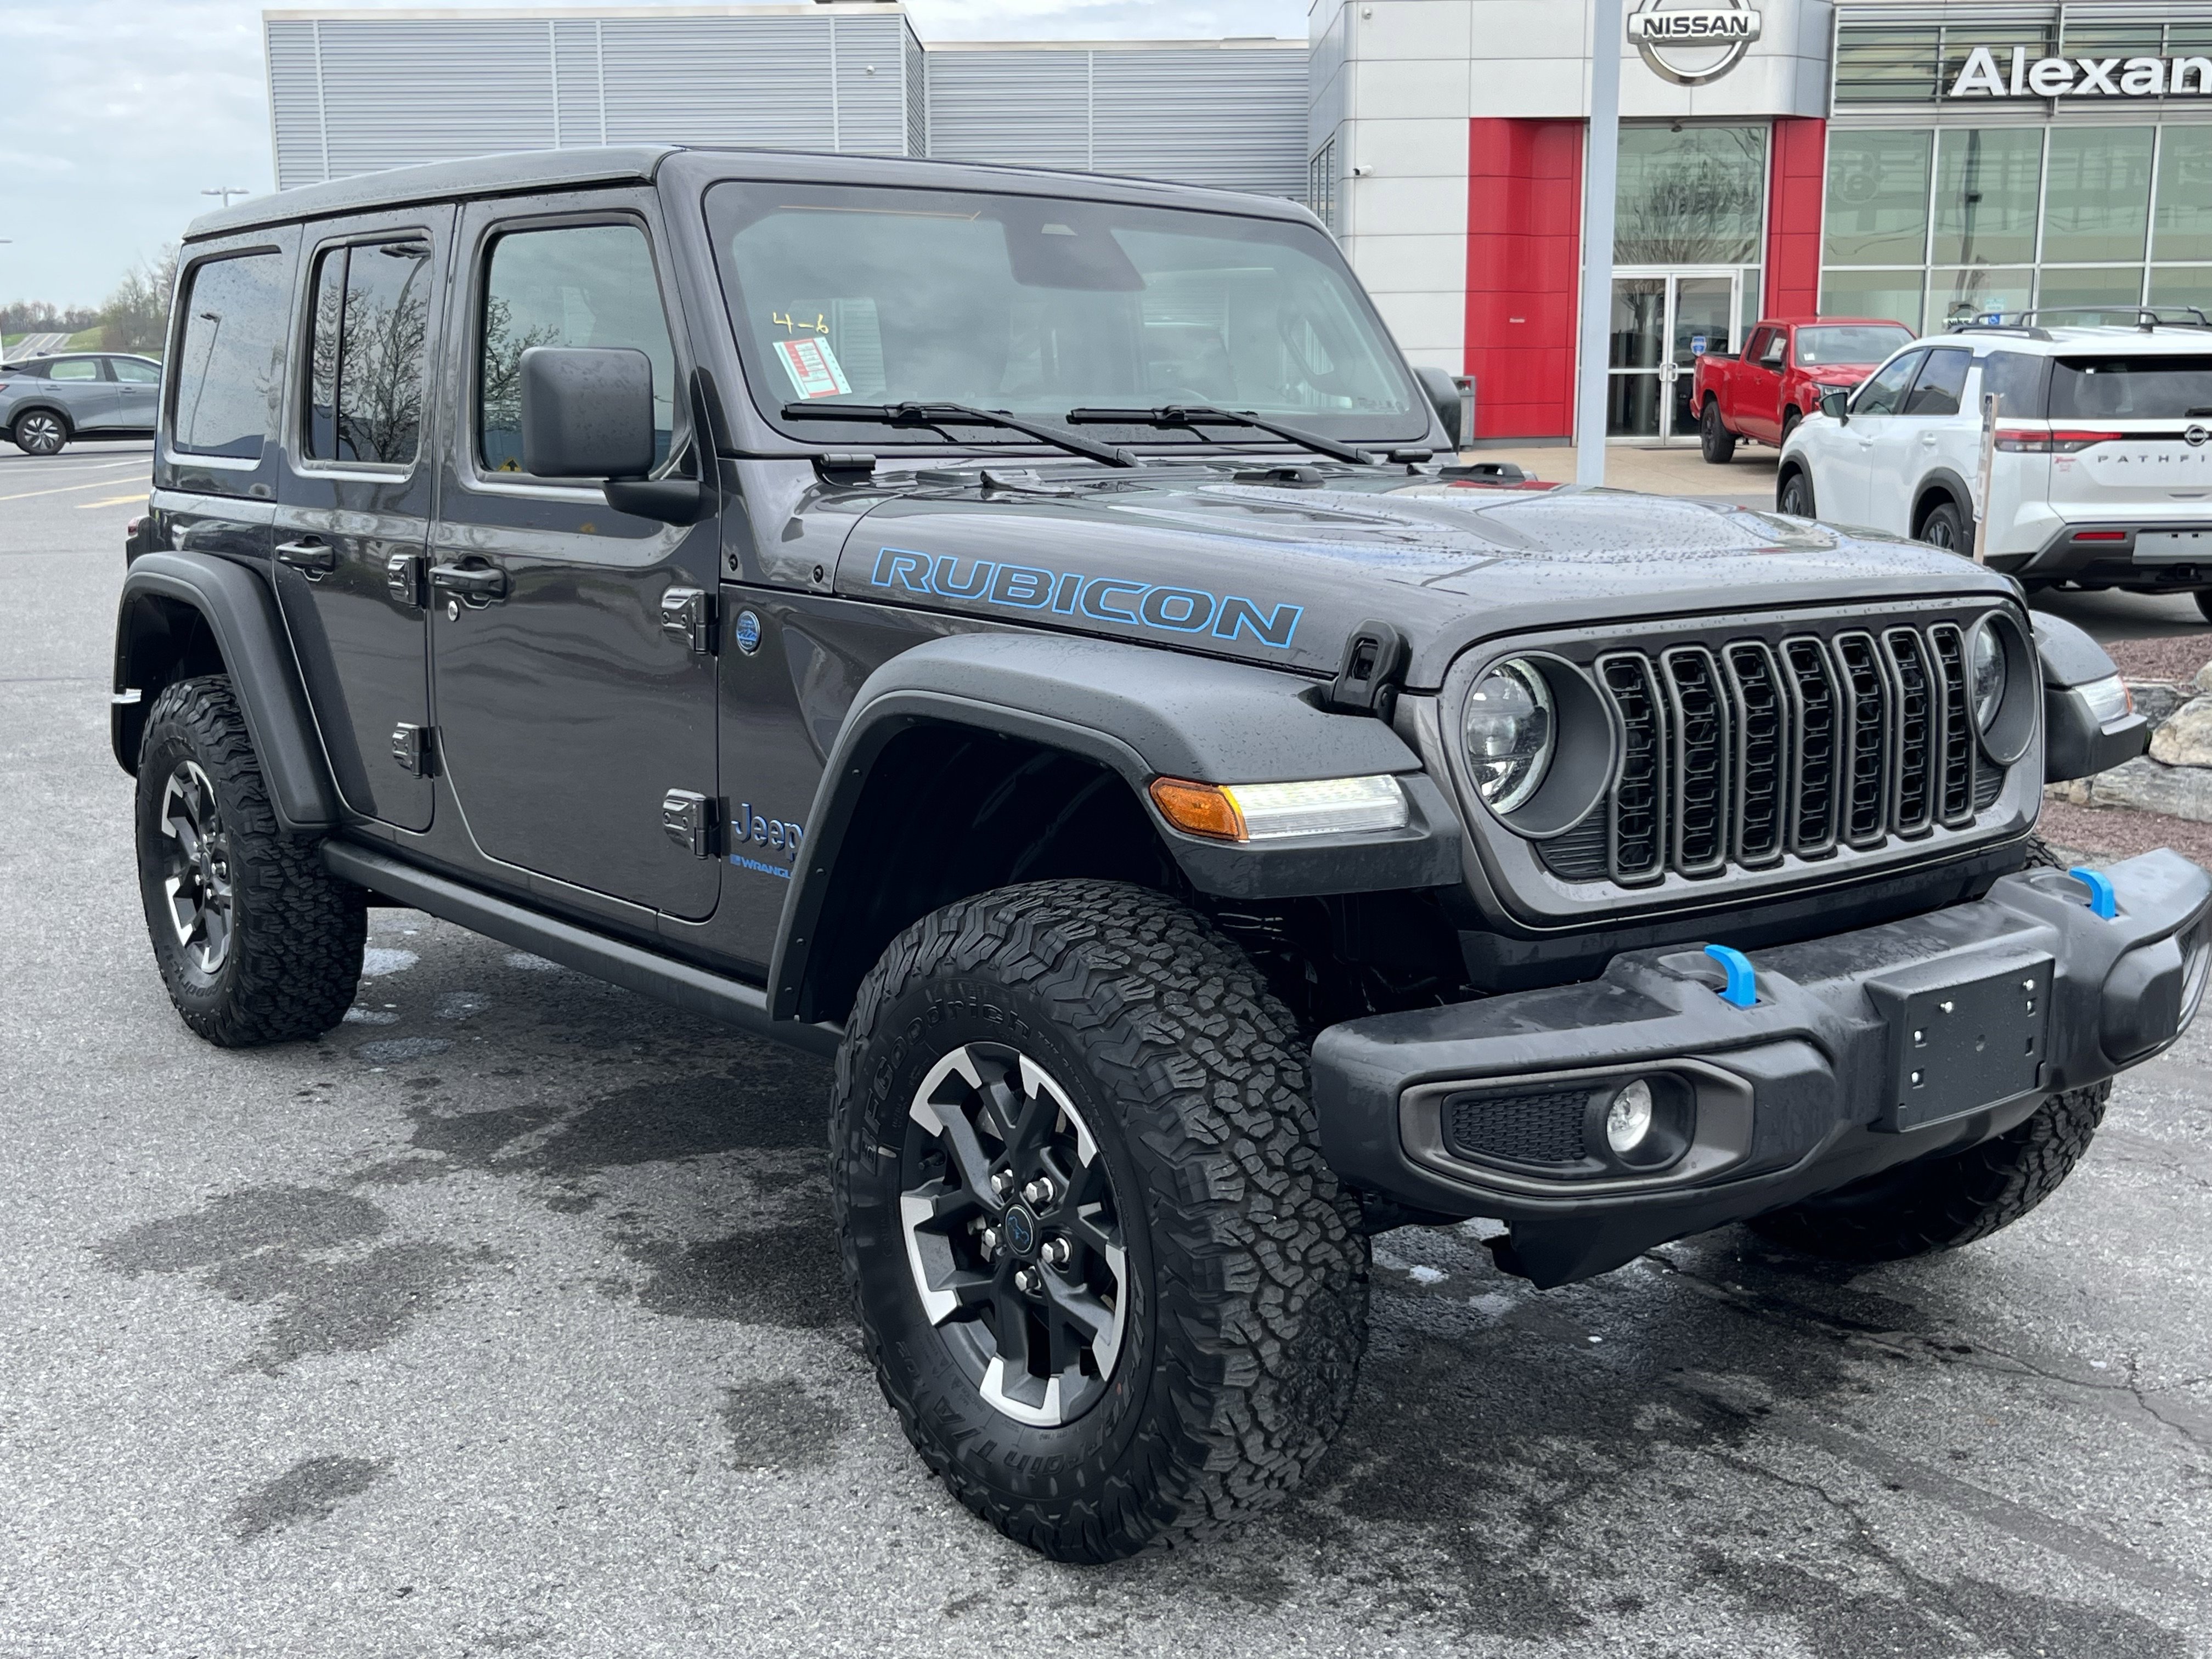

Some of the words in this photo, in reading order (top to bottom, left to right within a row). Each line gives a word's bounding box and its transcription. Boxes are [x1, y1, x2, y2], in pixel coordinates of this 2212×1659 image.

[1643, 15, 1749, 37] NISSAN
[1950, 46, 2212, 97] Alexan
[772, 312, 829, 334] 4-6
[2097, 454, 2205, 463] PATHFI
[871, 547, 1305, 649] RUBICON
[731, 802, 804, 863] Jeep
